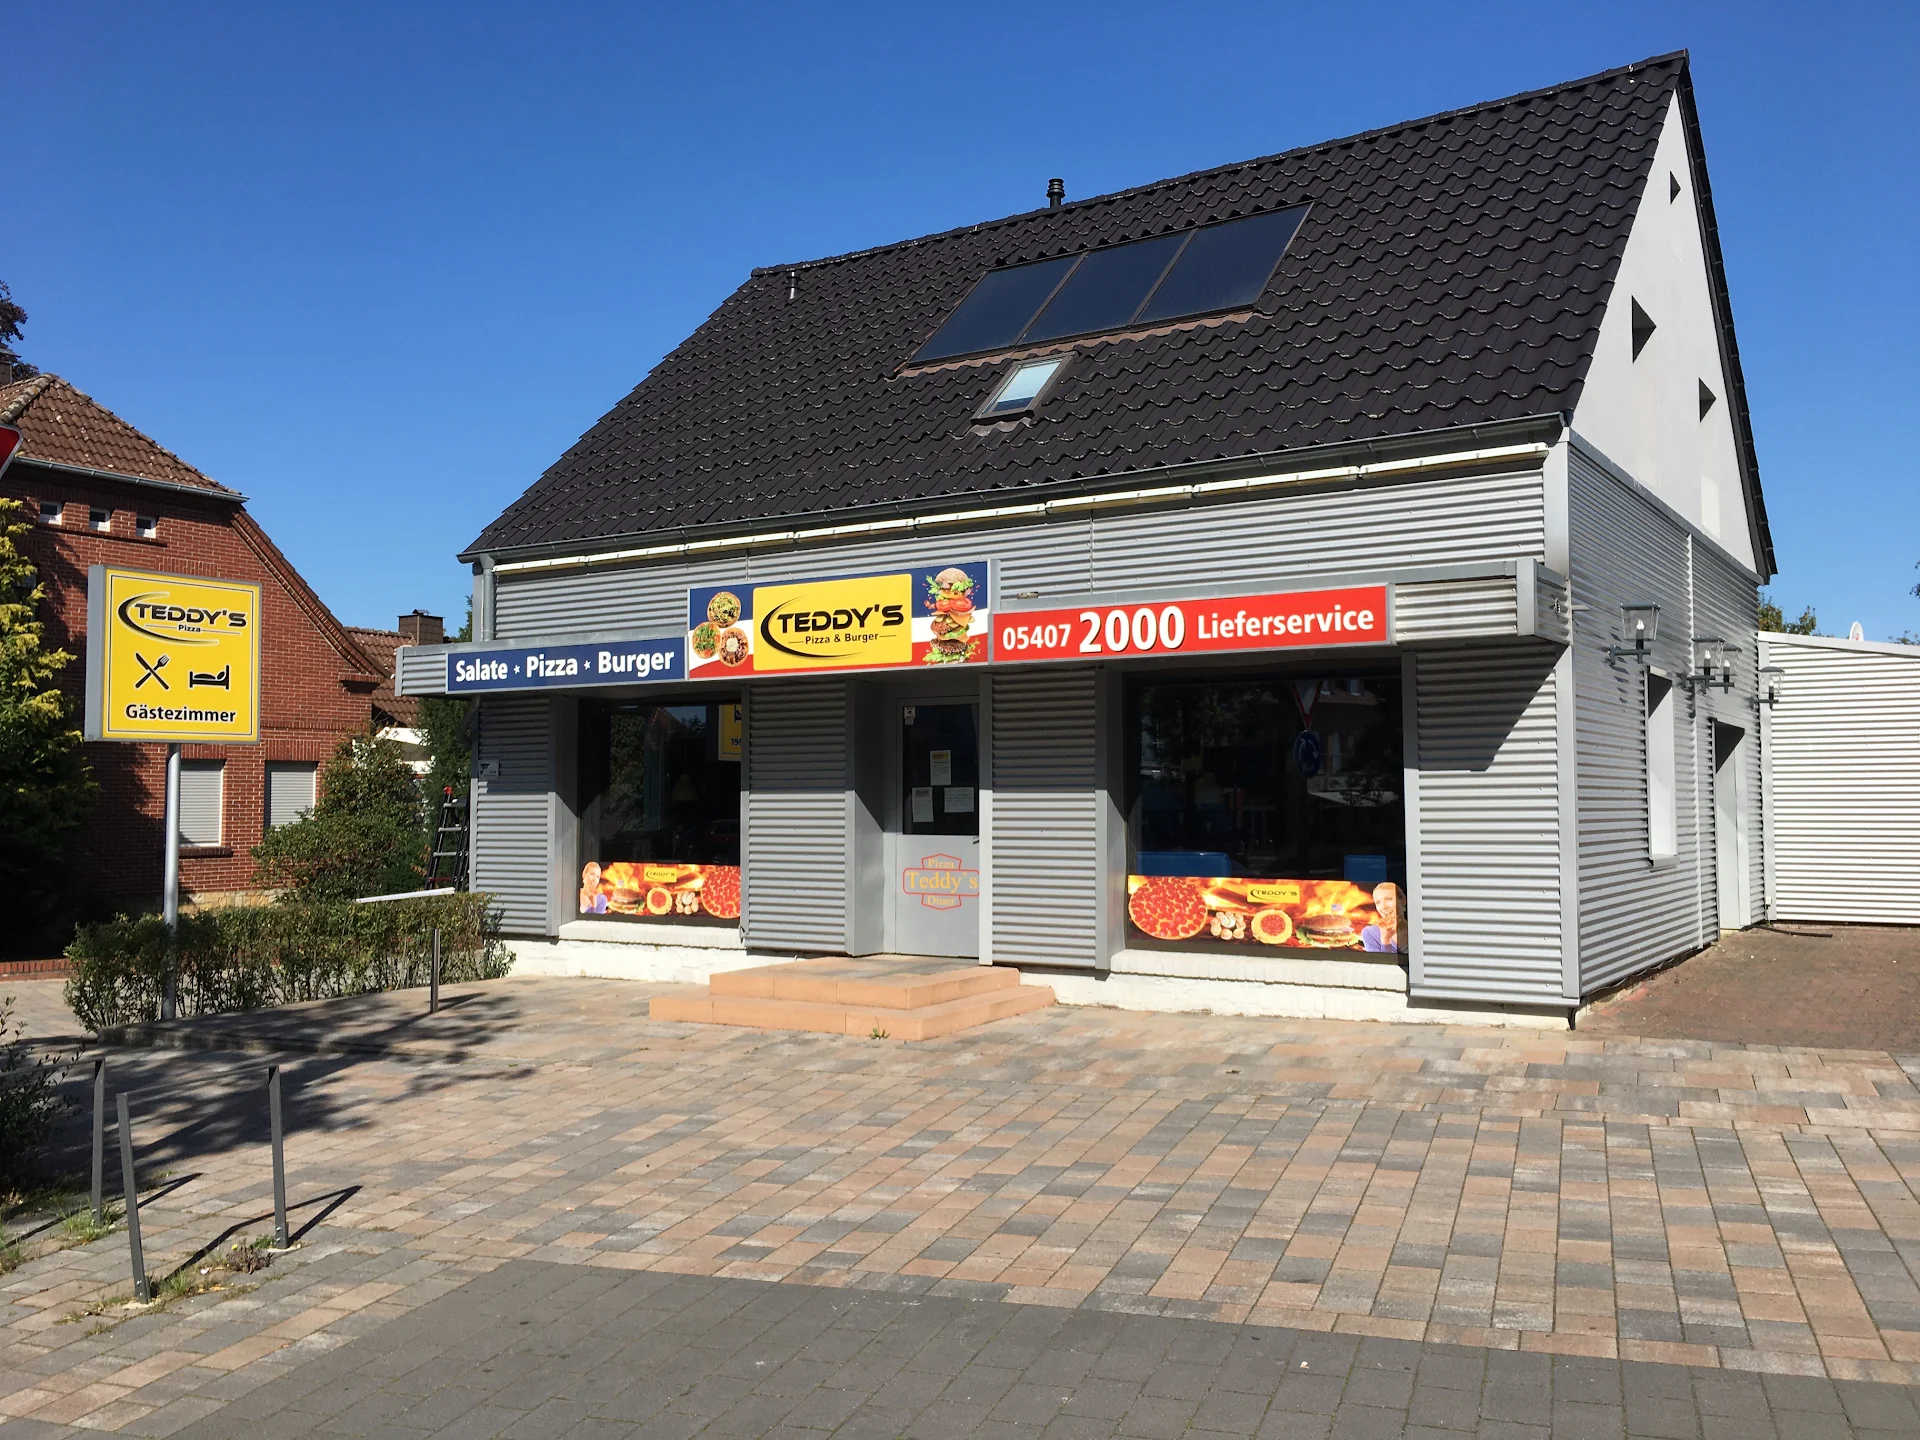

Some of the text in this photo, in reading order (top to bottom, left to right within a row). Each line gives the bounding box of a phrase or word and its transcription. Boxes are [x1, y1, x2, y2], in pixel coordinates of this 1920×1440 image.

[134, 602, 247, 628] TEDDY'S
[776, 603, 905, 634] TEDDY'S
[177, 624, 201, 633] Pizza
[1002, 604, 1374, 653] 05407 2000 Lieferservice
[805, 633, 879, 645] Pizza & Burger
[455, 651, 675, 682] Salate Pizza Burger
[125, 703, 236, 723] Gästezimmer
[927, 858, 955, 869] Pizza
[927, 895, 956, 906] Diner
